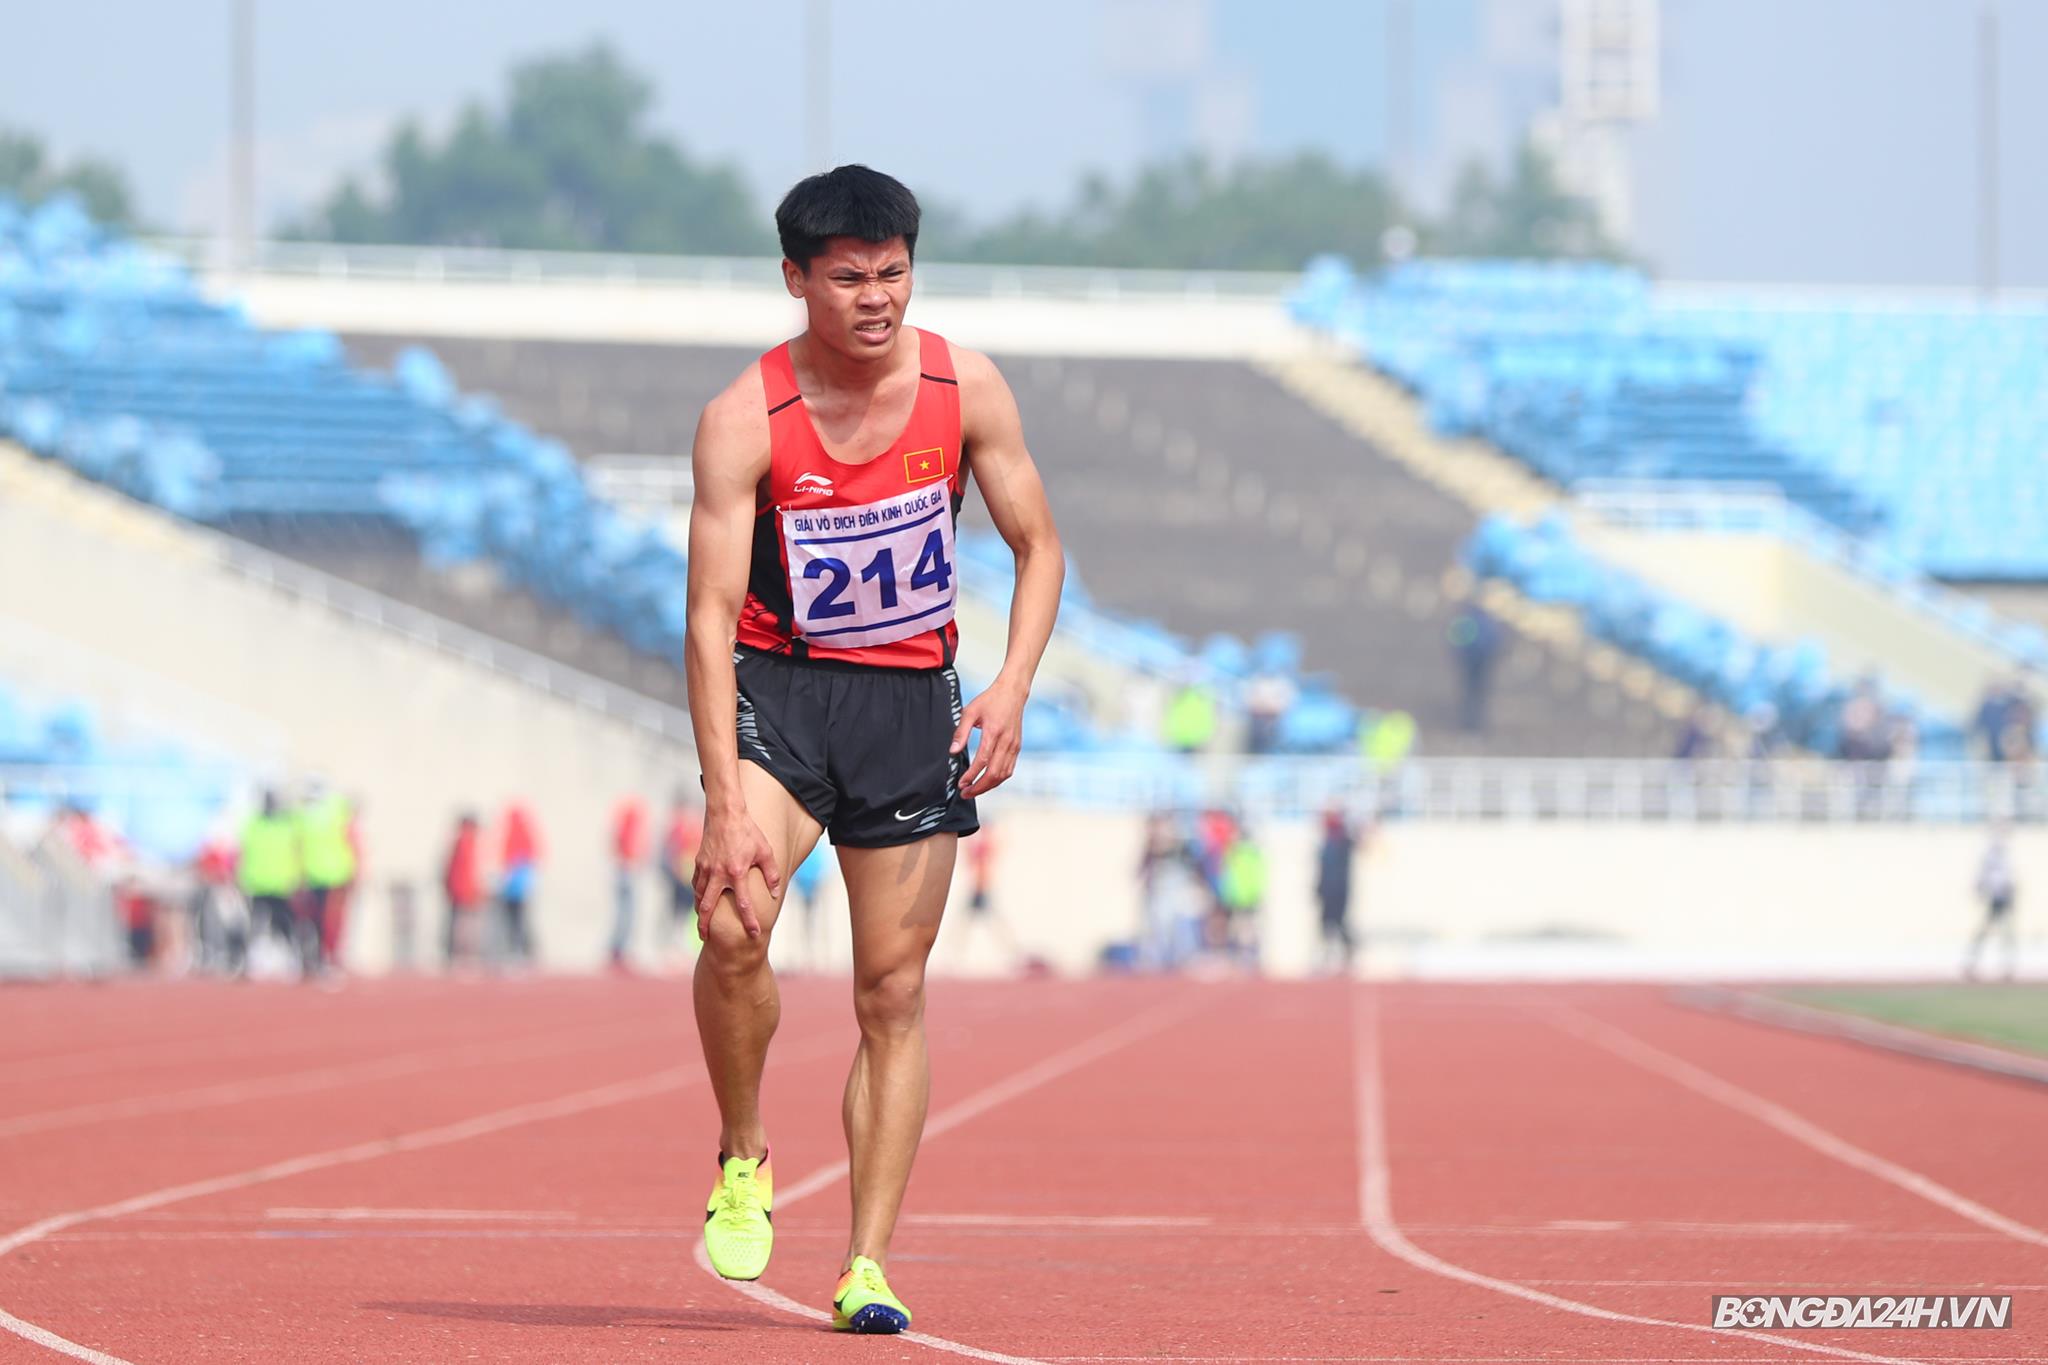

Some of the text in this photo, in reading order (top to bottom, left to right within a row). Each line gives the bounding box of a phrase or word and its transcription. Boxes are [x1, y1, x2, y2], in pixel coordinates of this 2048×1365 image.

[793, 485, 834, 497] LI-NING
[881, 504, 902, 521] KINH
[930, 489, 942, 505] GIA
[803, 528, 952, 621] 214
